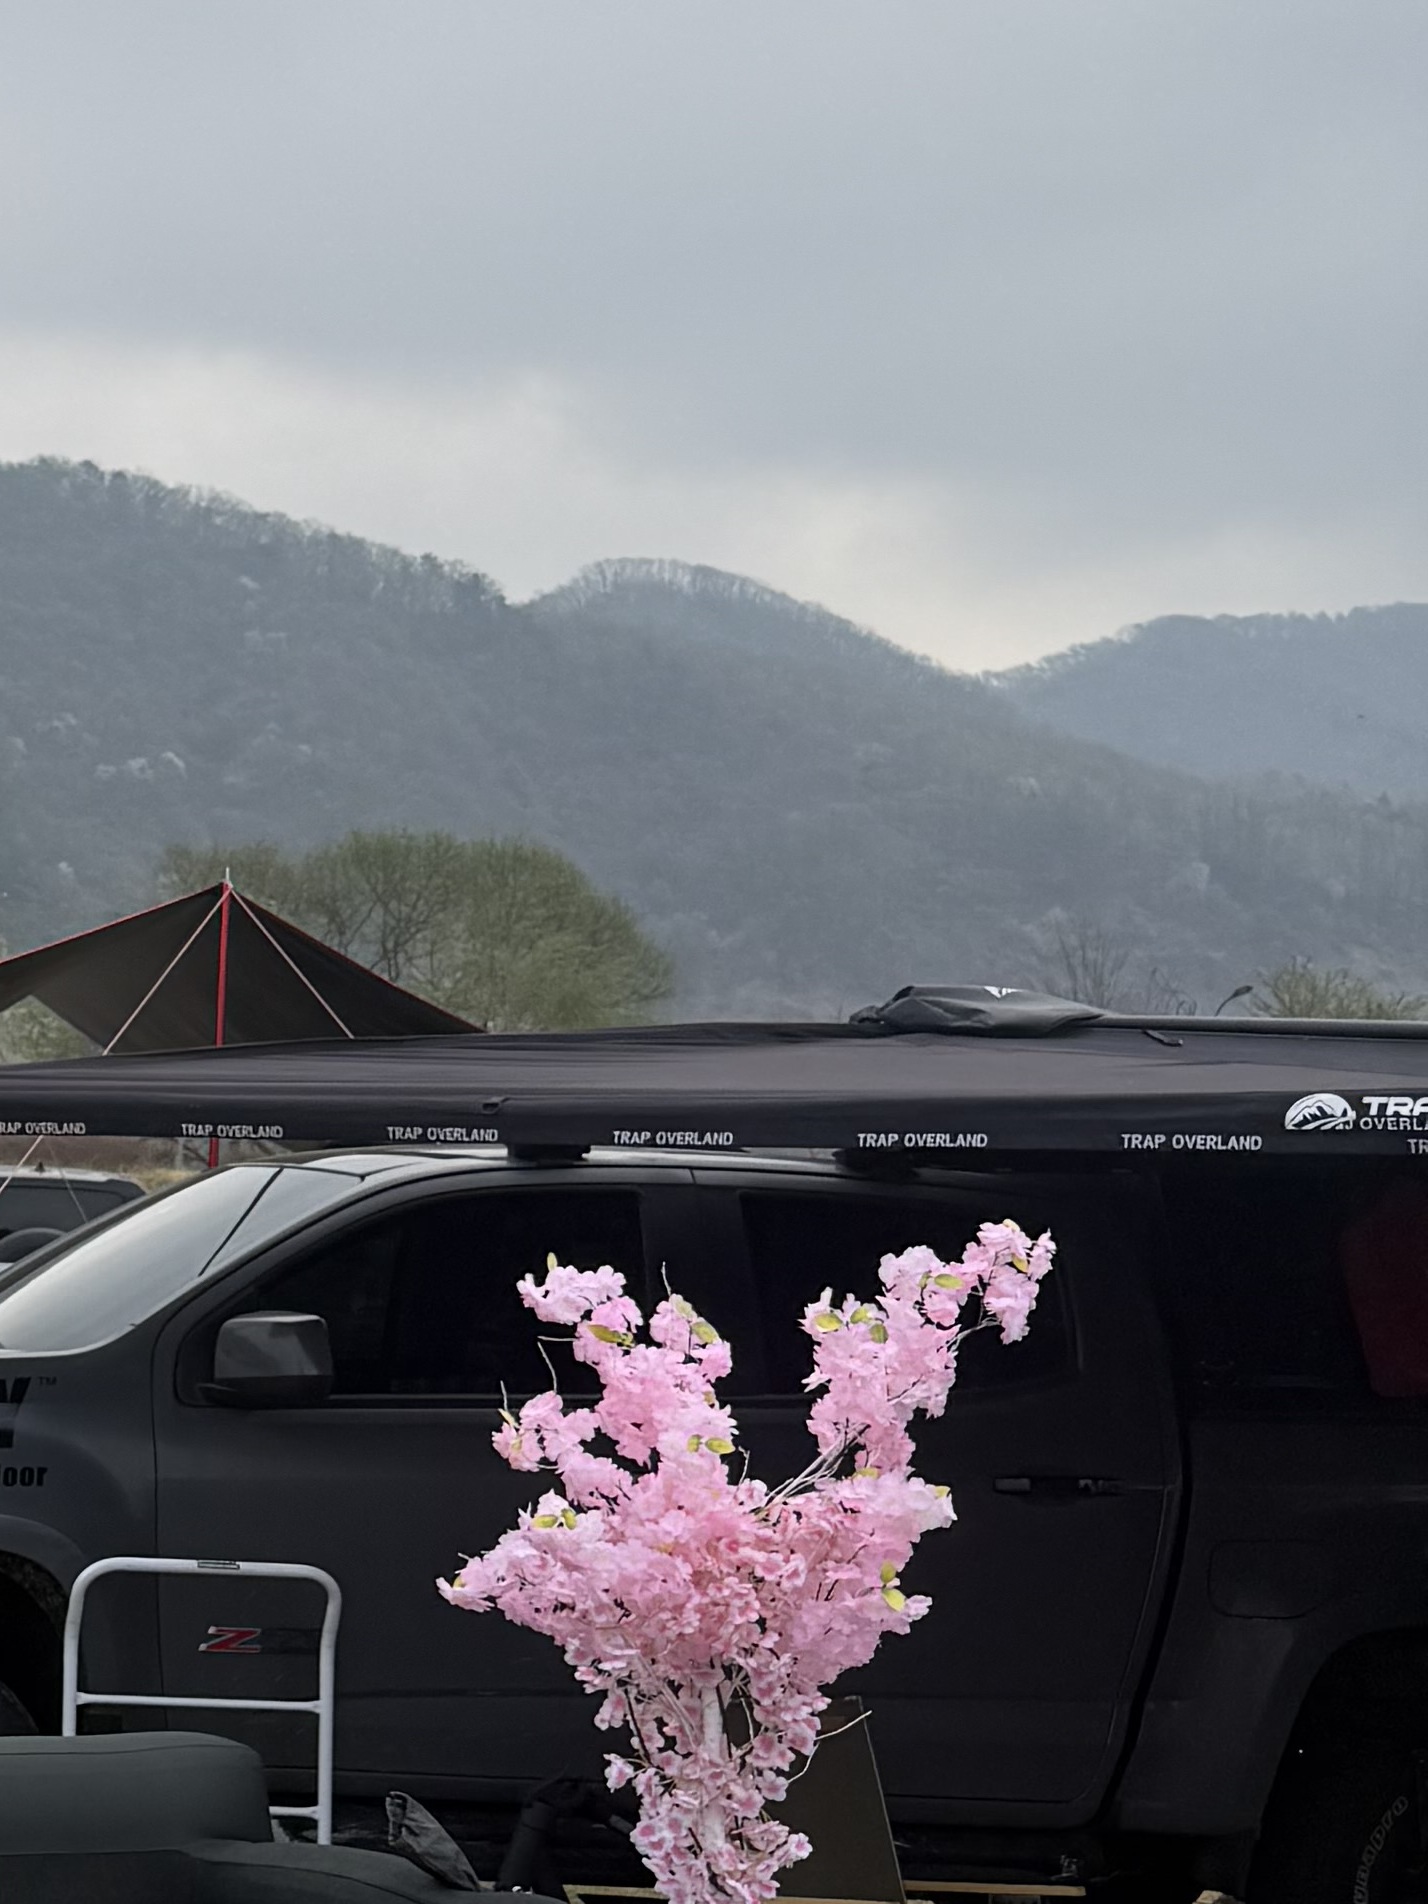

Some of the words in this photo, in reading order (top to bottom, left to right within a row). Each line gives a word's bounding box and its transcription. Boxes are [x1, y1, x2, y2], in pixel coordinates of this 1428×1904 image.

[25, 1122, 86, 1135] OVERLAND
[181, 1123, 213, 1137] TRAP
[217, 1125, 283, 1139] OVERLAND
[387, 1126, 423, 1141] TRAP
[428, 1127, 498, 1142] OVERLAND
[613, 1130, 650, 1145] TRAP
[656, 1131, 733, 1146] OVERLAND
[857, 1133, 899, 1148] TRAP
[904, 1133, 988, 1148] OVERLAND
[1121, 1133, 1166, 1150] TRAP
[1172, 1134, 1262, 1151] OVERLAND
